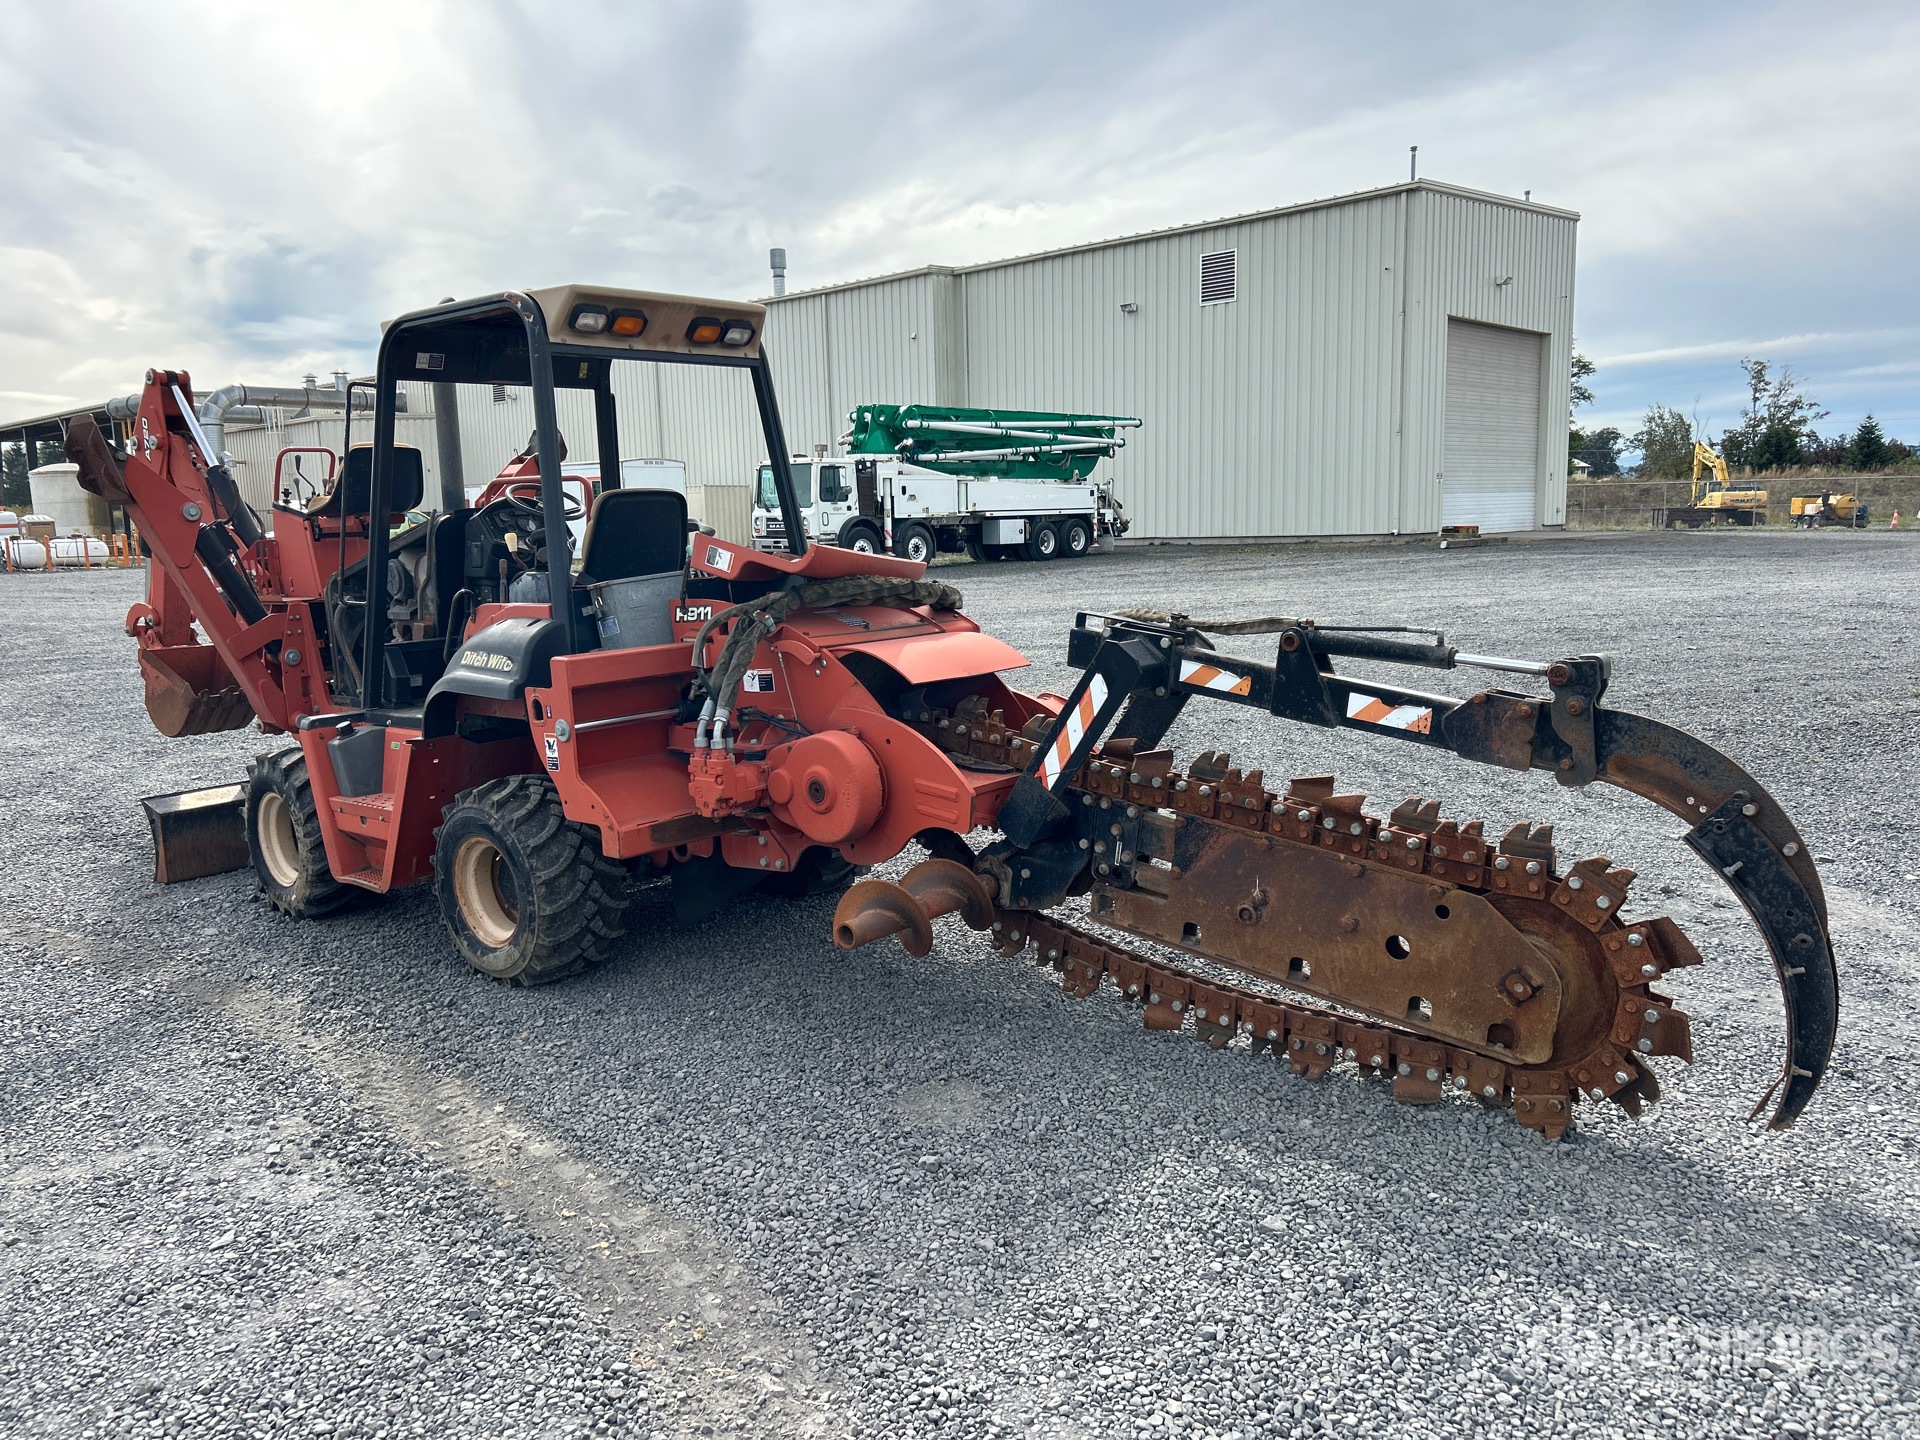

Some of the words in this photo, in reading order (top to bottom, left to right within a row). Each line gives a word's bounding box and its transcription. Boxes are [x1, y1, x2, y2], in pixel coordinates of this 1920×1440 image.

[675, 606, 712, 622] H911
[460, 650, 488, 667] Ditch
[487, 653, 513, 672] Witc
